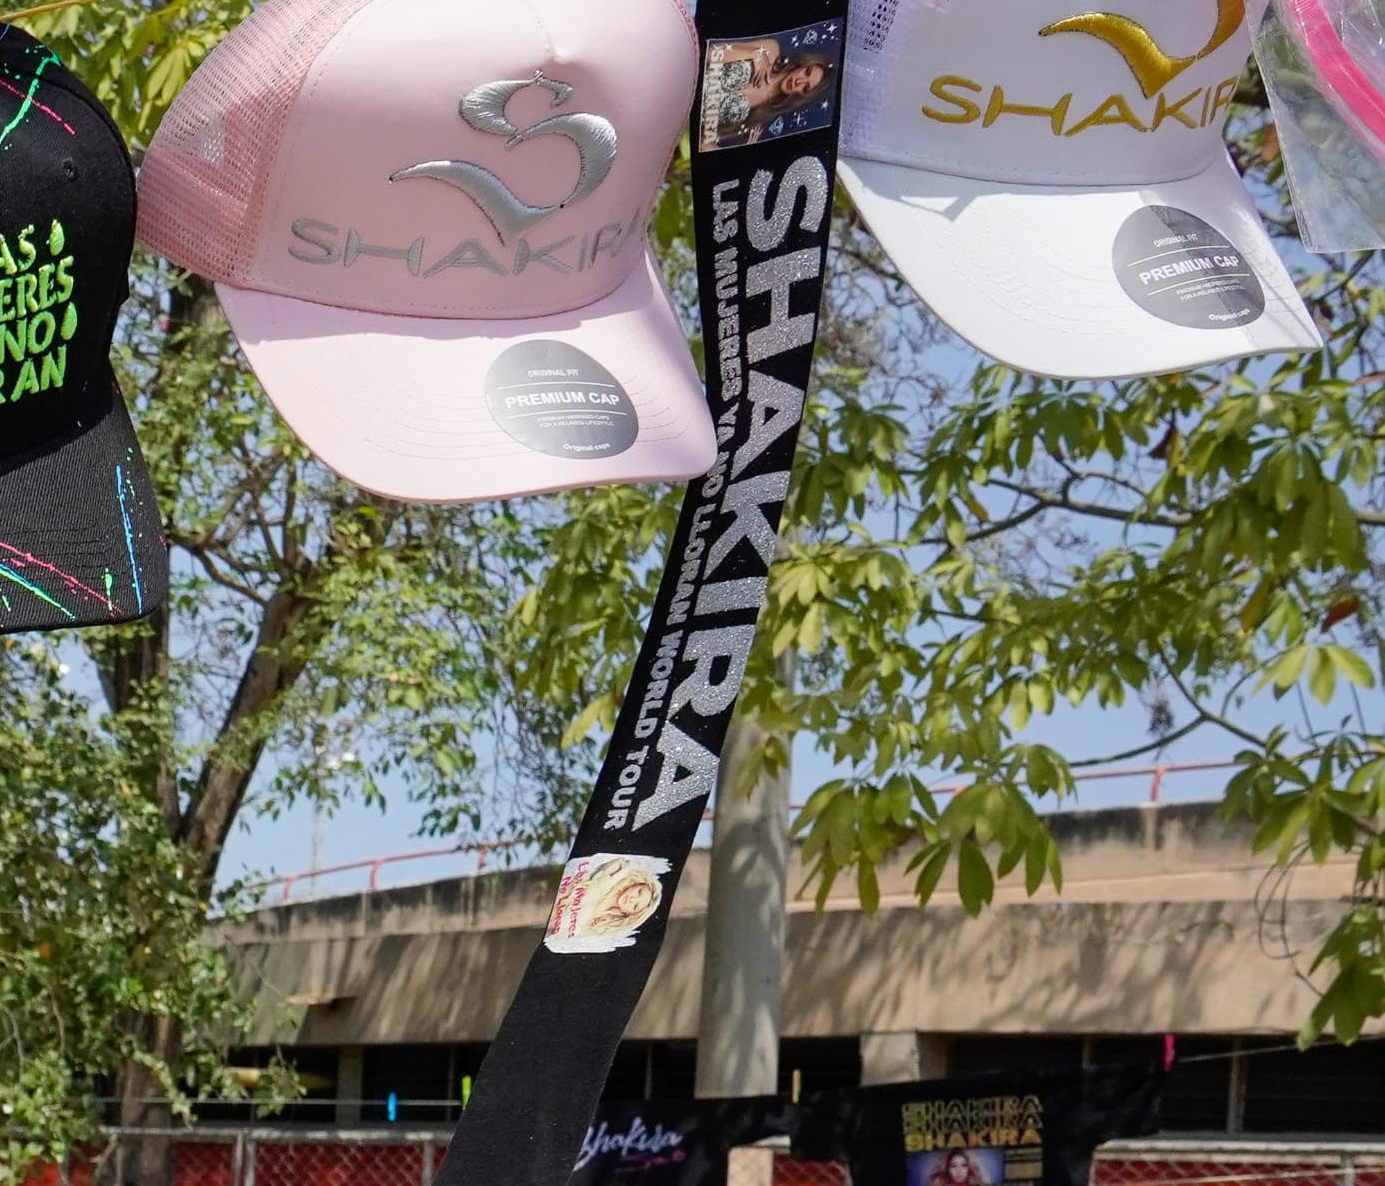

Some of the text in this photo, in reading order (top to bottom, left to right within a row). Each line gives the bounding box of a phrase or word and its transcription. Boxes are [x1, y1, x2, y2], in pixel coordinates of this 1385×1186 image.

[713, 178, 740, 244] LAS
[1139, 255, 1239, 285] PREMIUM CAP
[714, 251, 741, 402] MUJERES
[504, 391, 620, 409] PREMIUM CAP
[527, 368, 566, 378] ORIGINAL
[562, 442, 594, 452] Original
[631, 155, 829, 832] SHAKIRA
[667, 502, 717, 627] LLORAN
[634, 628, 675, 740] WORLD
[602, 748, 650, 832] TOUR
[904, 1128, 1042, 1152] SHAKIRA
